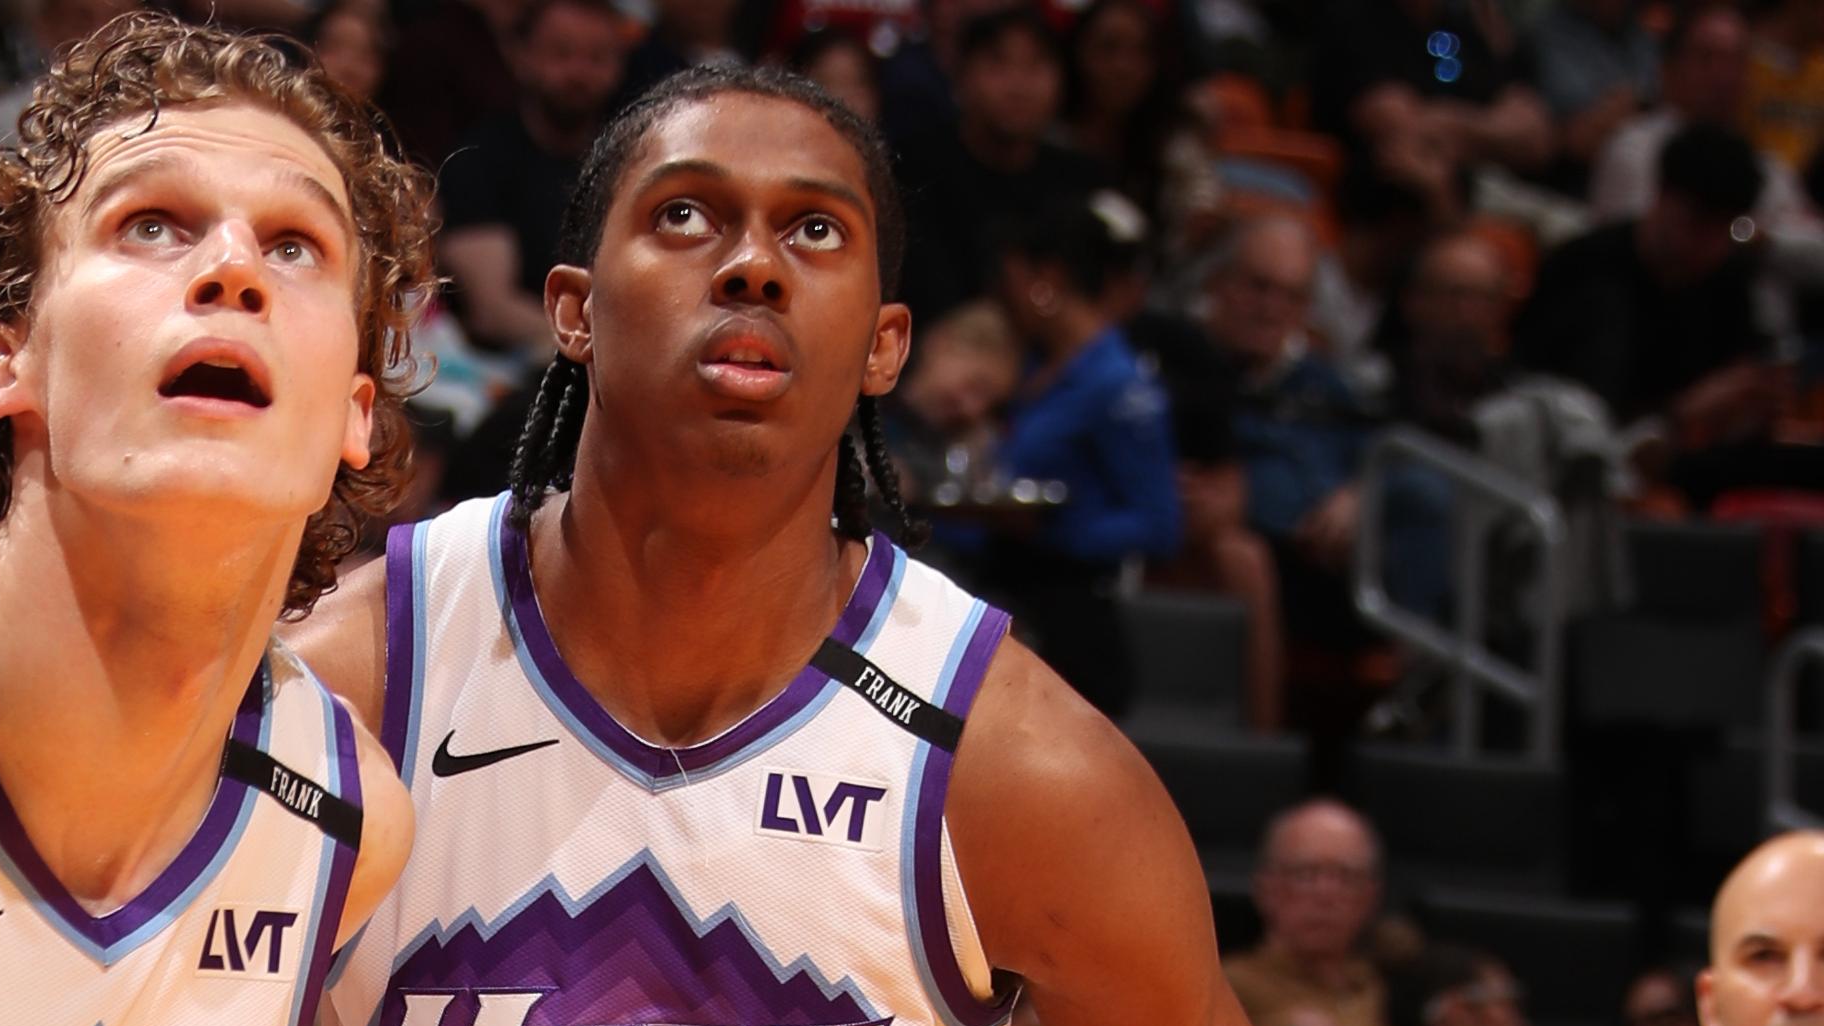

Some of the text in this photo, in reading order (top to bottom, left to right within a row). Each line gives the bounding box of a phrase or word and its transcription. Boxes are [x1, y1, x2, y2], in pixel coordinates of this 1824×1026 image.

[854, 666, 920, 725] FRANK
[270, 766, 324, 818] FRANK
[760, 772, 889, 843] LVT
[198, 909, 299, 974] LVT
